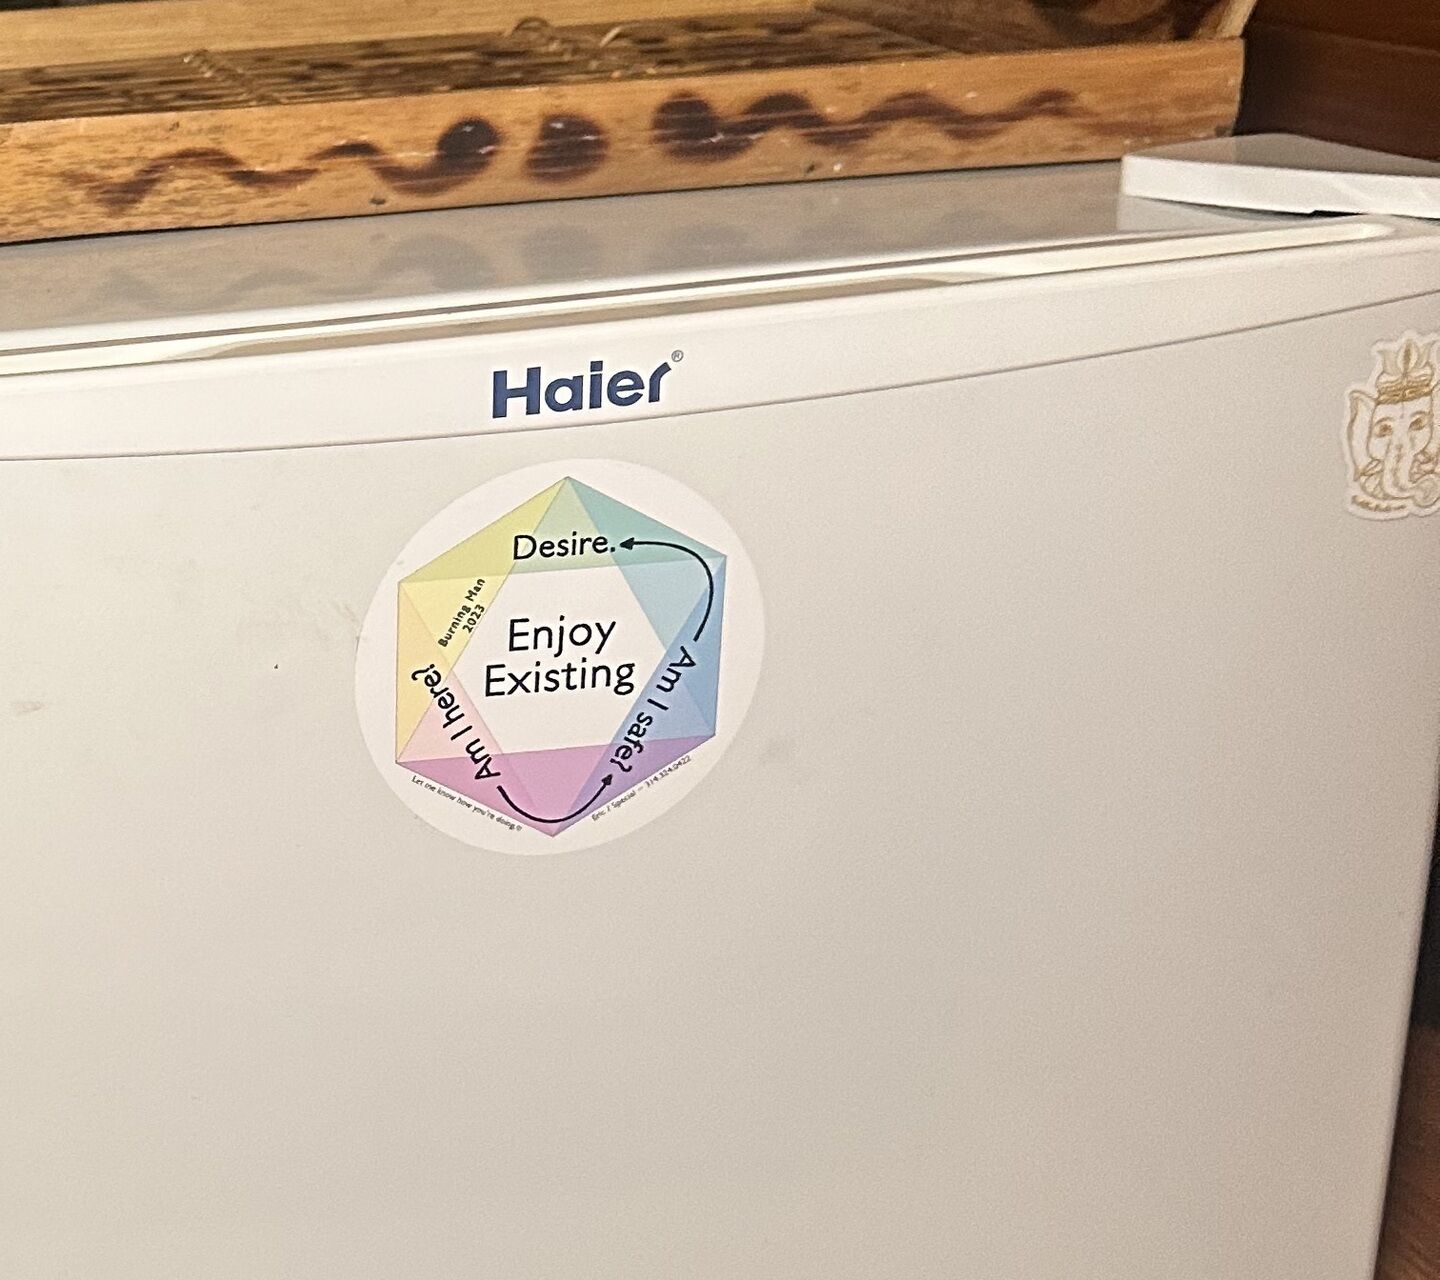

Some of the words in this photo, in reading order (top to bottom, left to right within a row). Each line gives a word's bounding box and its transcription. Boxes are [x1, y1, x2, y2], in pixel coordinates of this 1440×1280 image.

[513, 531, 616, 560] Desire.
[437, 605, 472, 648] Burning
[464, 578, 486, 602] Man
[462, 604, 486, 634] 2023
[508, 615, 617, 658] Enjoy
[485, 657, 636, 697] Existing
[655, 645, 696, 693] Am
[411, 663, 465, 729] here?
[647, 698, 669, 711] I
[450, 725, 473, 741] I
[609, 712, 654, 773] safe?
[465, 738, 502, 780] Am
[411, 775, 423, 786] Let
[424, 783, 436, 792] me
[436, 787, 456, 802] know
[456, 797, 472, 809] how
